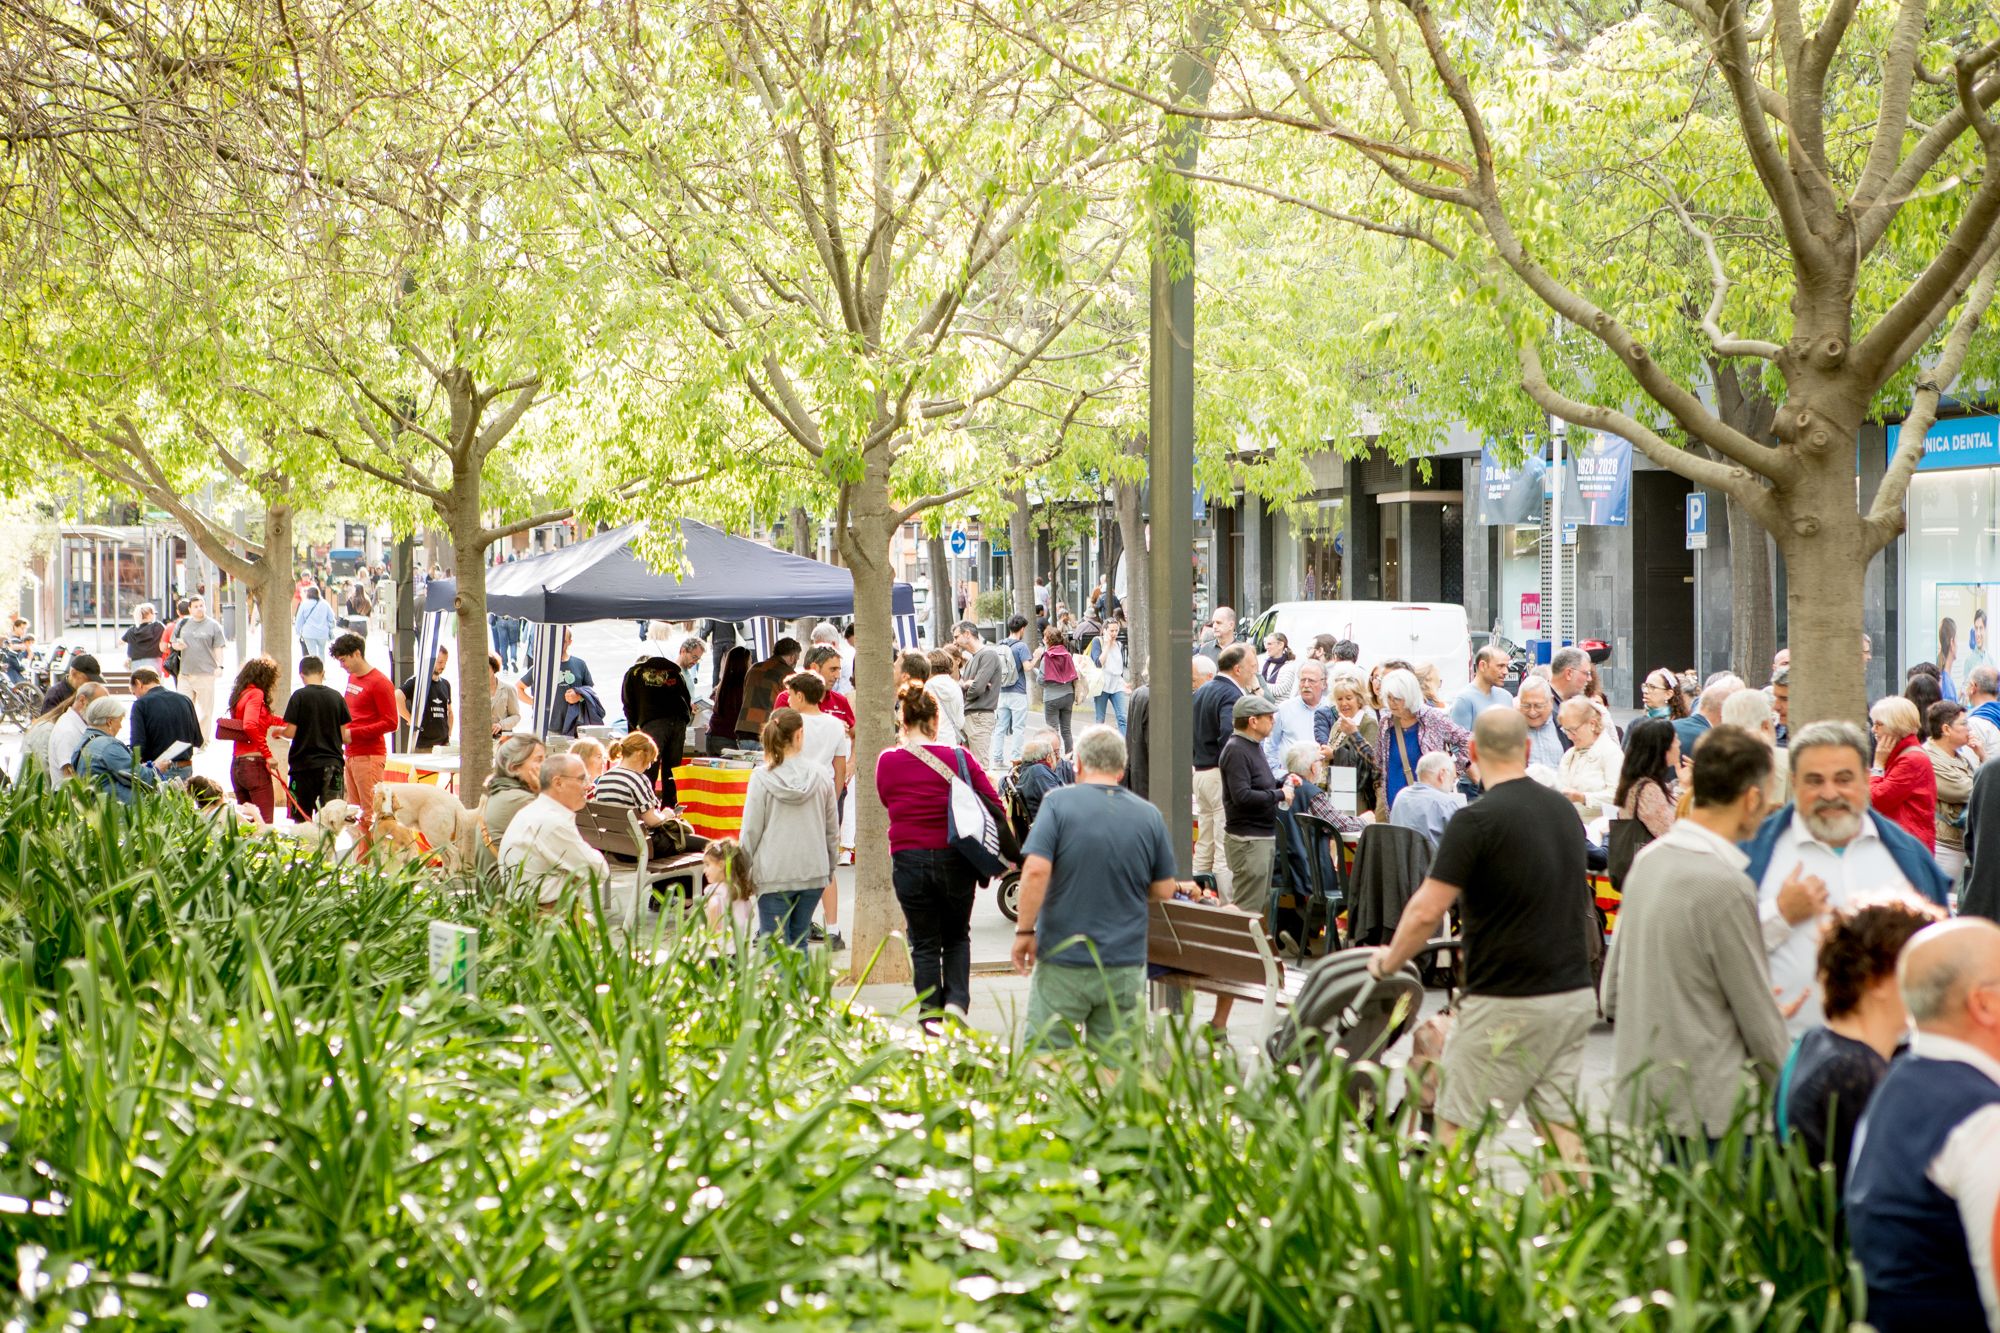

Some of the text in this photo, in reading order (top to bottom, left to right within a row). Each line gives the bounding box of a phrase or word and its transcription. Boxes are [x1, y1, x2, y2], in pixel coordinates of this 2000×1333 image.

[1923, 432, 1993, 453] NICA DENTAL
[1691, 498, 1702, 530] P
